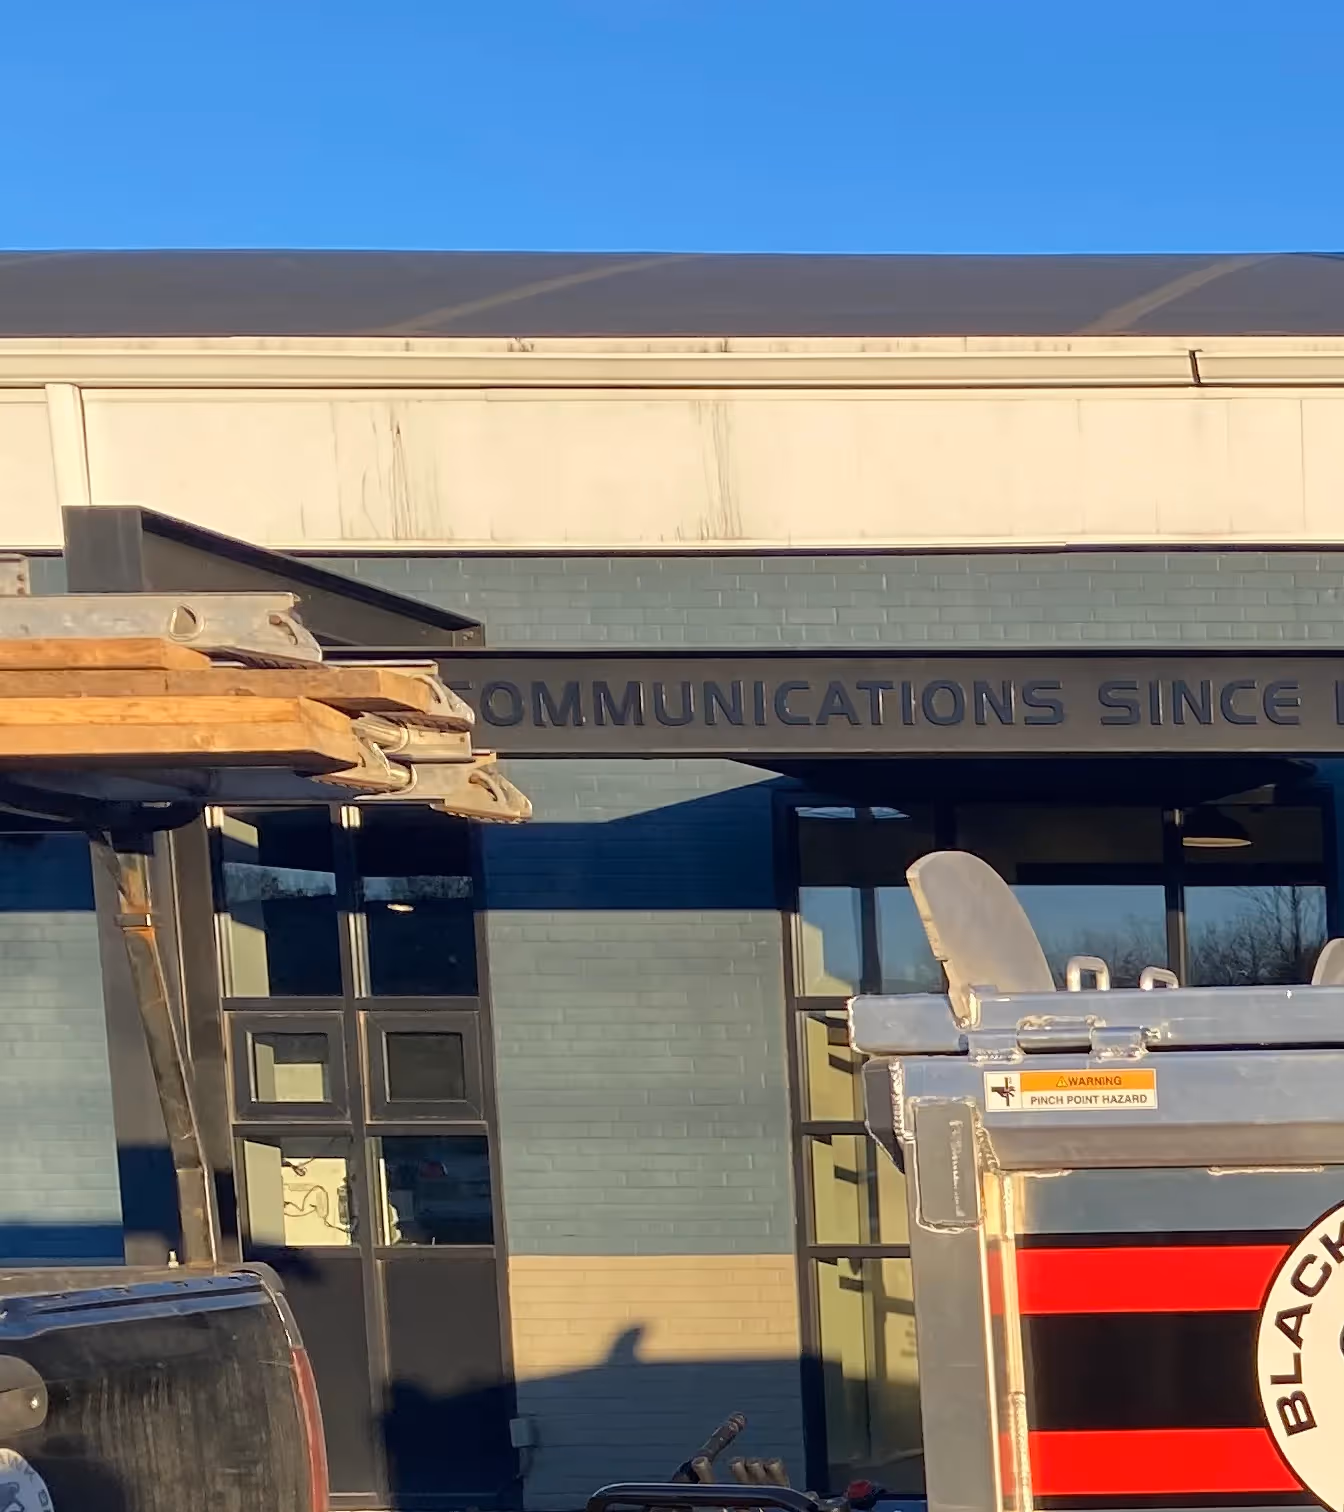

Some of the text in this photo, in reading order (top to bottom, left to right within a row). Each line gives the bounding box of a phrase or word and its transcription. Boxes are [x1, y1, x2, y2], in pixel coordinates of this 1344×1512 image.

[1099, 680, 1301, 727] SINCE
[1068, 1075, 1122, 1087] WARNING
[1030, 1093, 1148, 1106] PINCH POINT HAZARD
